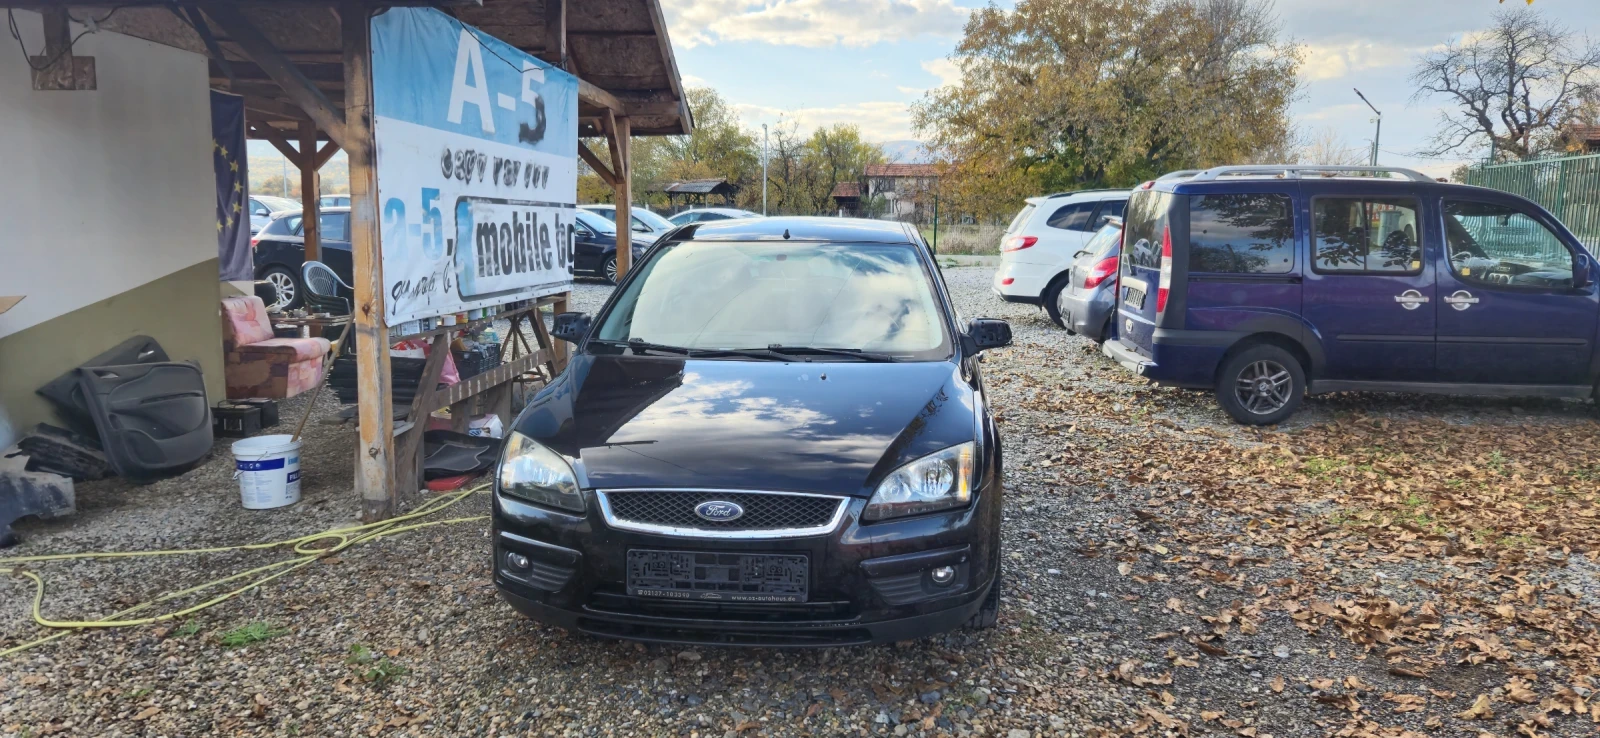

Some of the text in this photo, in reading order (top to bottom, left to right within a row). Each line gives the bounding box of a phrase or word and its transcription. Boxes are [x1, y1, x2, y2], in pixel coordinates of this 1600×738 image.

[447, 29, 547, 144] A-5
[476, 211, 553, 277] mobile
[706, 505, 732, 516] Ford
